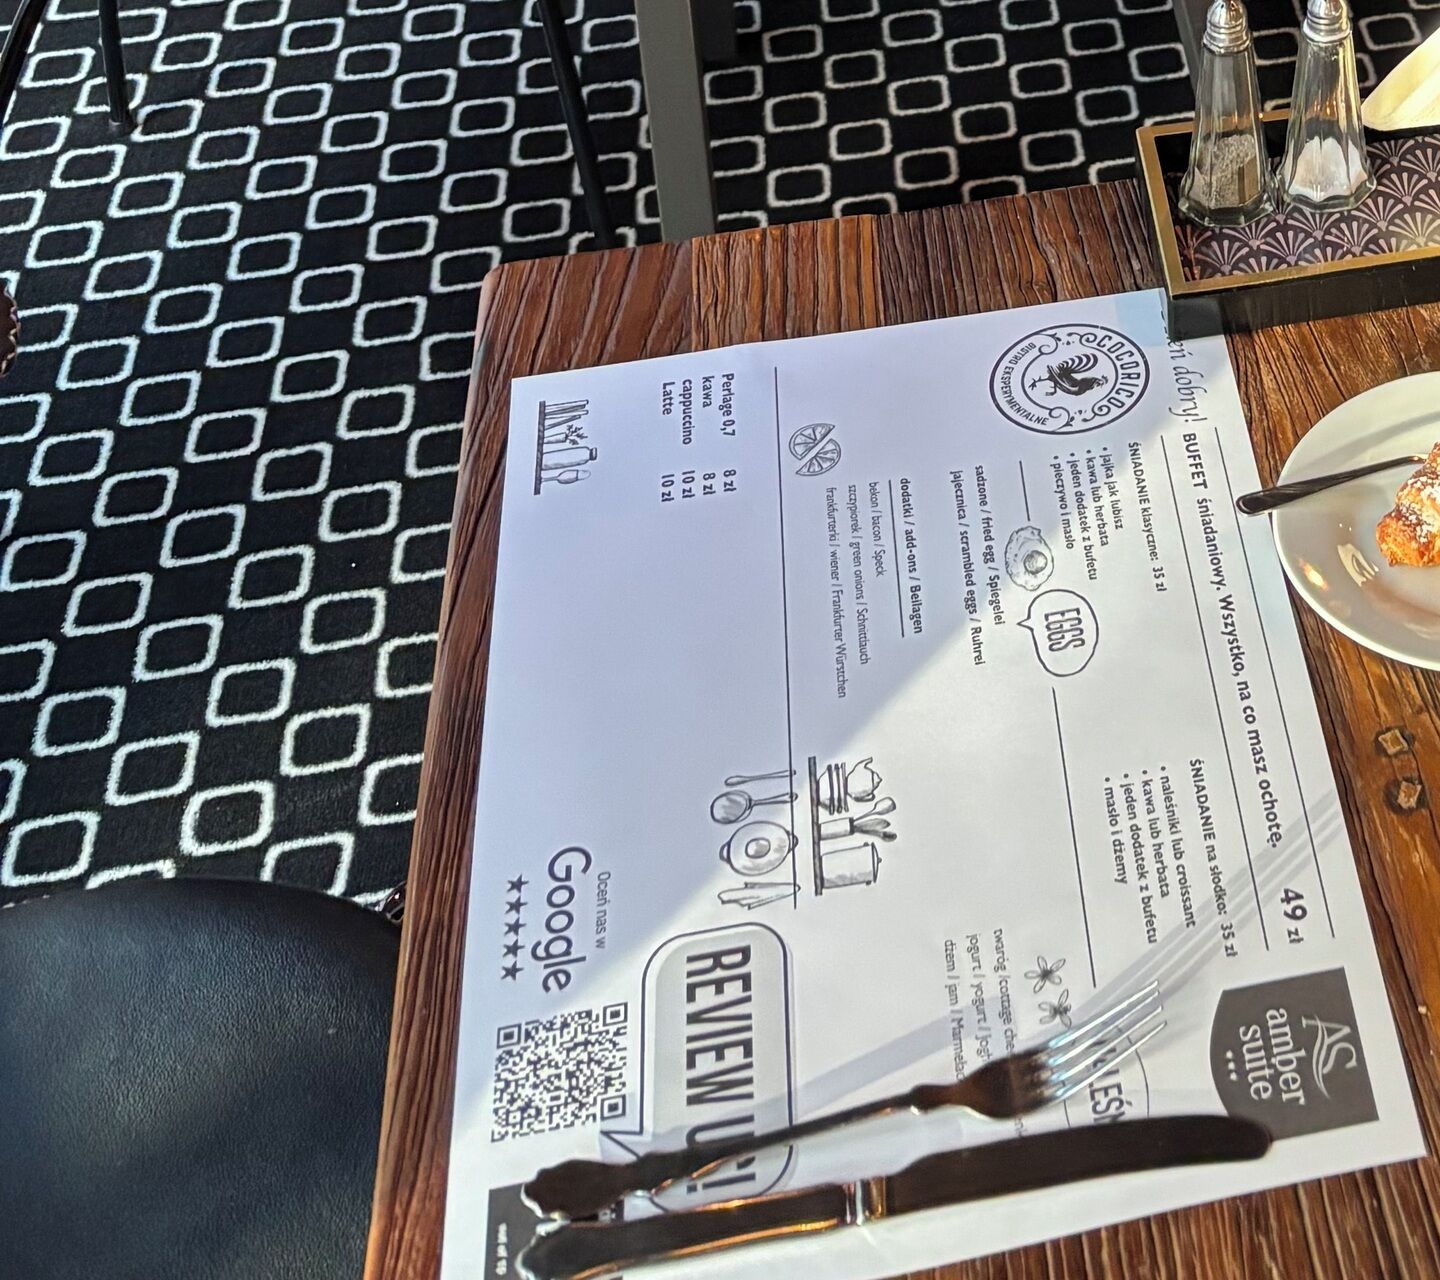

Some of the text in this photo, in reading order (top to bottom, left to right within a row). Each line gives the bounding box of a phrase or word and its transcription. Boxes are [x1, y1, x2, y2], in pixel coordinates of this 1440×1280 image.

[662, 382, 675, 415] Latte
[702, 375, 715, 408] kawa
[1001, 342, 1049, 426] BISTRO EKSPERYMENTALNE
[1096, 334, 1141, 408] COCORICO
[1168, 366, 1207, 423] dobry!
[679, 379, 695, 445] cappuccino
[718, 373, 736, 436] Perlage 0,7
[661, 474, 675, 502] 10 zł
[682, 470, 695, 499] 10 zł
[703, 473, 716, 495] 8 zł
[723, 481, 737, 492] zł
[949, 470, 968, 521] jajecznica
[1066, 460, 1083, 489] jeden
[1085, 457, 1110, 547] kawa lub herbata
[1099, 454, 1124, 530] jajka jak lubisz
[868, 482, 887, 577] bekon bacon Speck
[1050, 463, 1067, 510] pieczywo
[1060, 519, 1075, 549] masło
[1074, 491, 1090, 532] dodatek
[1128, 442, 1167, 592] ŚNIADANIE klasyczne: 35 zł
[900, 478, 924, 634] dodatki add-ons Beilagen
[958, 530, 975, 587] scrambled
[974, 465, 1006, 625] sadzone fried egg Spiegelei
[1084, 545, 1098, 581] bufetu
[825, 487, 848, 698] frankfurterki wiener Frankfurter Würstchen
[846, 484, 871, 665] szczypiorek green onions Schnittlauch
[964, 589, 977, 615] eggs
[1043, 608, 1086, 652] EGGS
[1183, 433, 1285, 849] BUFFET śniadaniowy. Wszystko, na co masz ochotę.
[1102, 786, 1122, 828] masło
[1120, 782, 1139, 821] jeden
[1111, 839, 1129, 884] dżemy
[1128, 823, 1150, 881] dodatek
[1140, 778, 1172, 898] kawa lub herbata
[1159, 775, 1197, 928] naleśniki lub croissant
[1189, 758, 1239, 958] ŚNIADANIE na słodko: 35 zł
[530, 846, 592, 994] Google
[594, 871, 612, 950] Oceń nas w
[1141, 896, 1160, 944] bufetu
[1279, 887, 1308, 944] 49 zł
[944, 939, 960, 972] dżem
[966, 934, 986, 973] jogurt
[993, 929, 1010, 972] twaróg
[945, 984, 961, 1006] jam
[971, 983, 990, 1025] yogurt
[685, 944, 754, 1107] REVIEW
[1238, 1024, 1275, 1101] suite
[1266, 1007, 1306, 1106] amber
